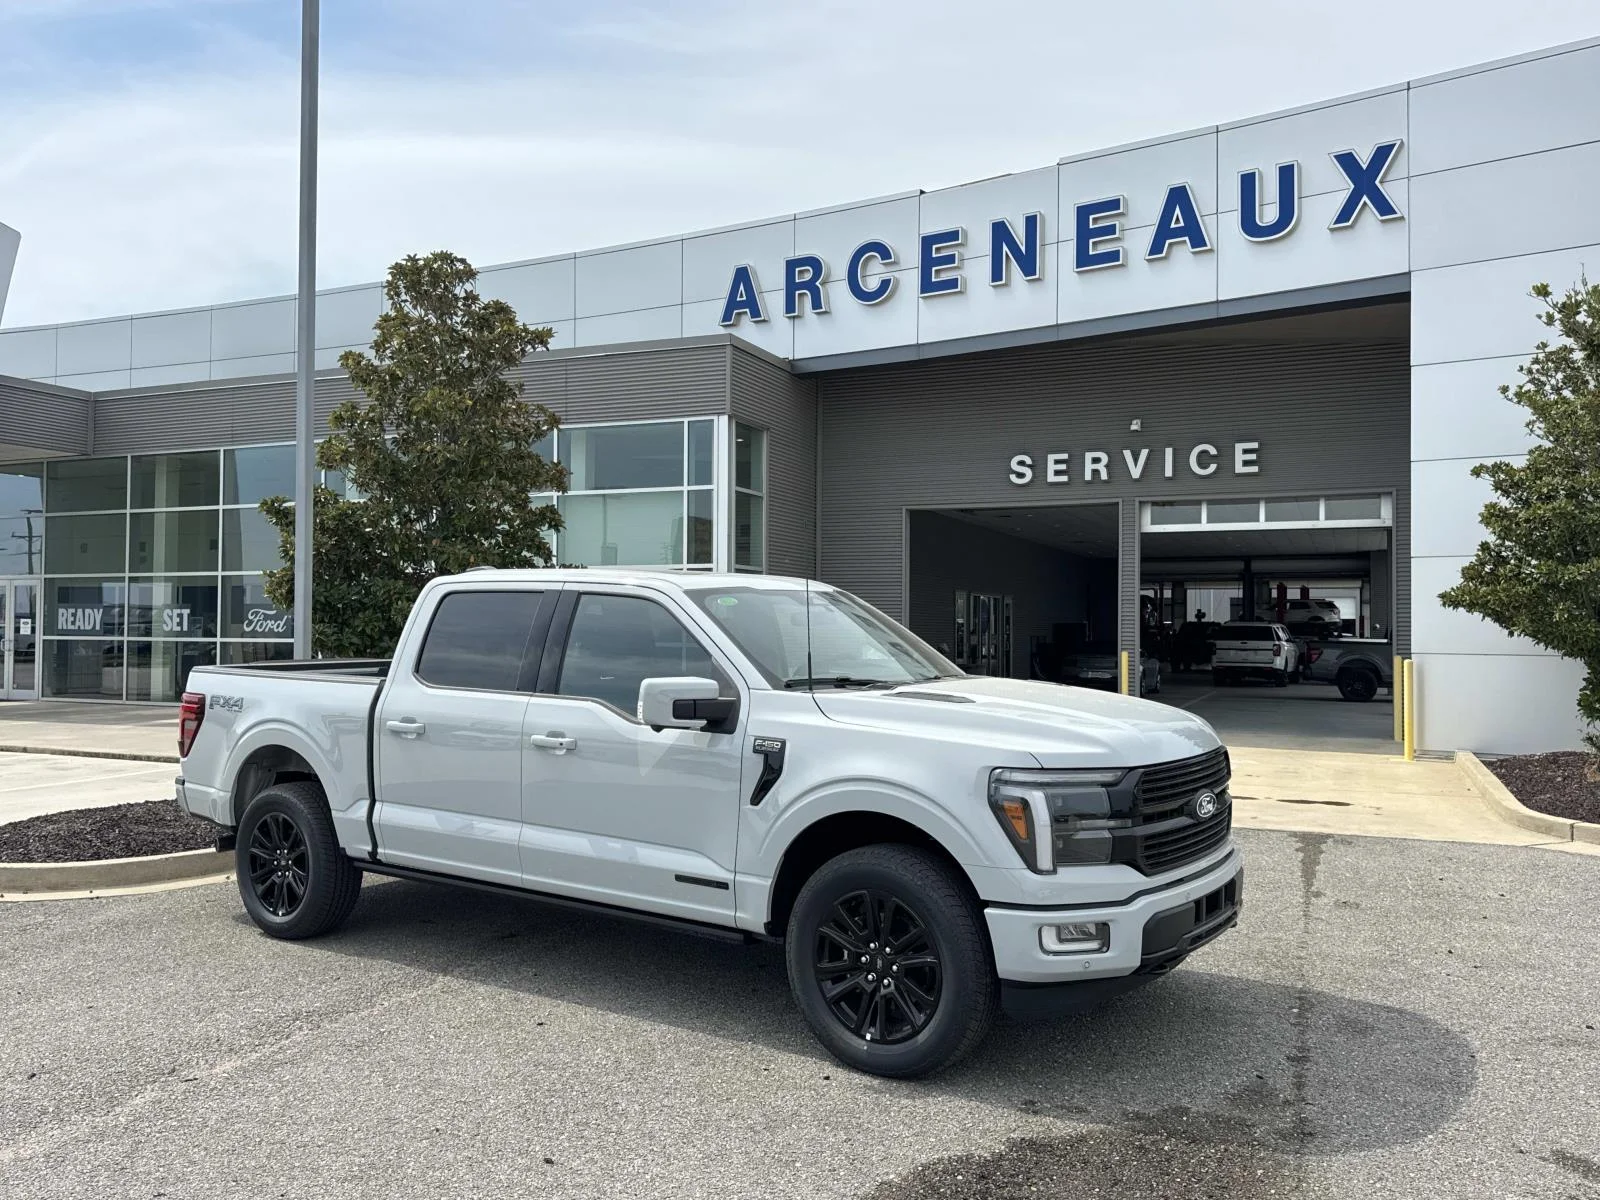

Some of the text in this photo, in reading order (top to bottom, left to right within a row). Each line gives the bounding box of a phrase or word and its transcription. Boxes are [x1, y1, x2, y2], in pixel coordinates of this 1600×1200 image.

[719, 139, 1405, 327] ARCENEAUX
[1009, 441, 1259, 485] SERVICE
[57, 607, 103, 631] READY
[162, 608, 191, 632] SET
[243, 608, 288, 633] Ford
[209, 694, 244, 710] FX4
[755, 739, 782, 749] F-150
